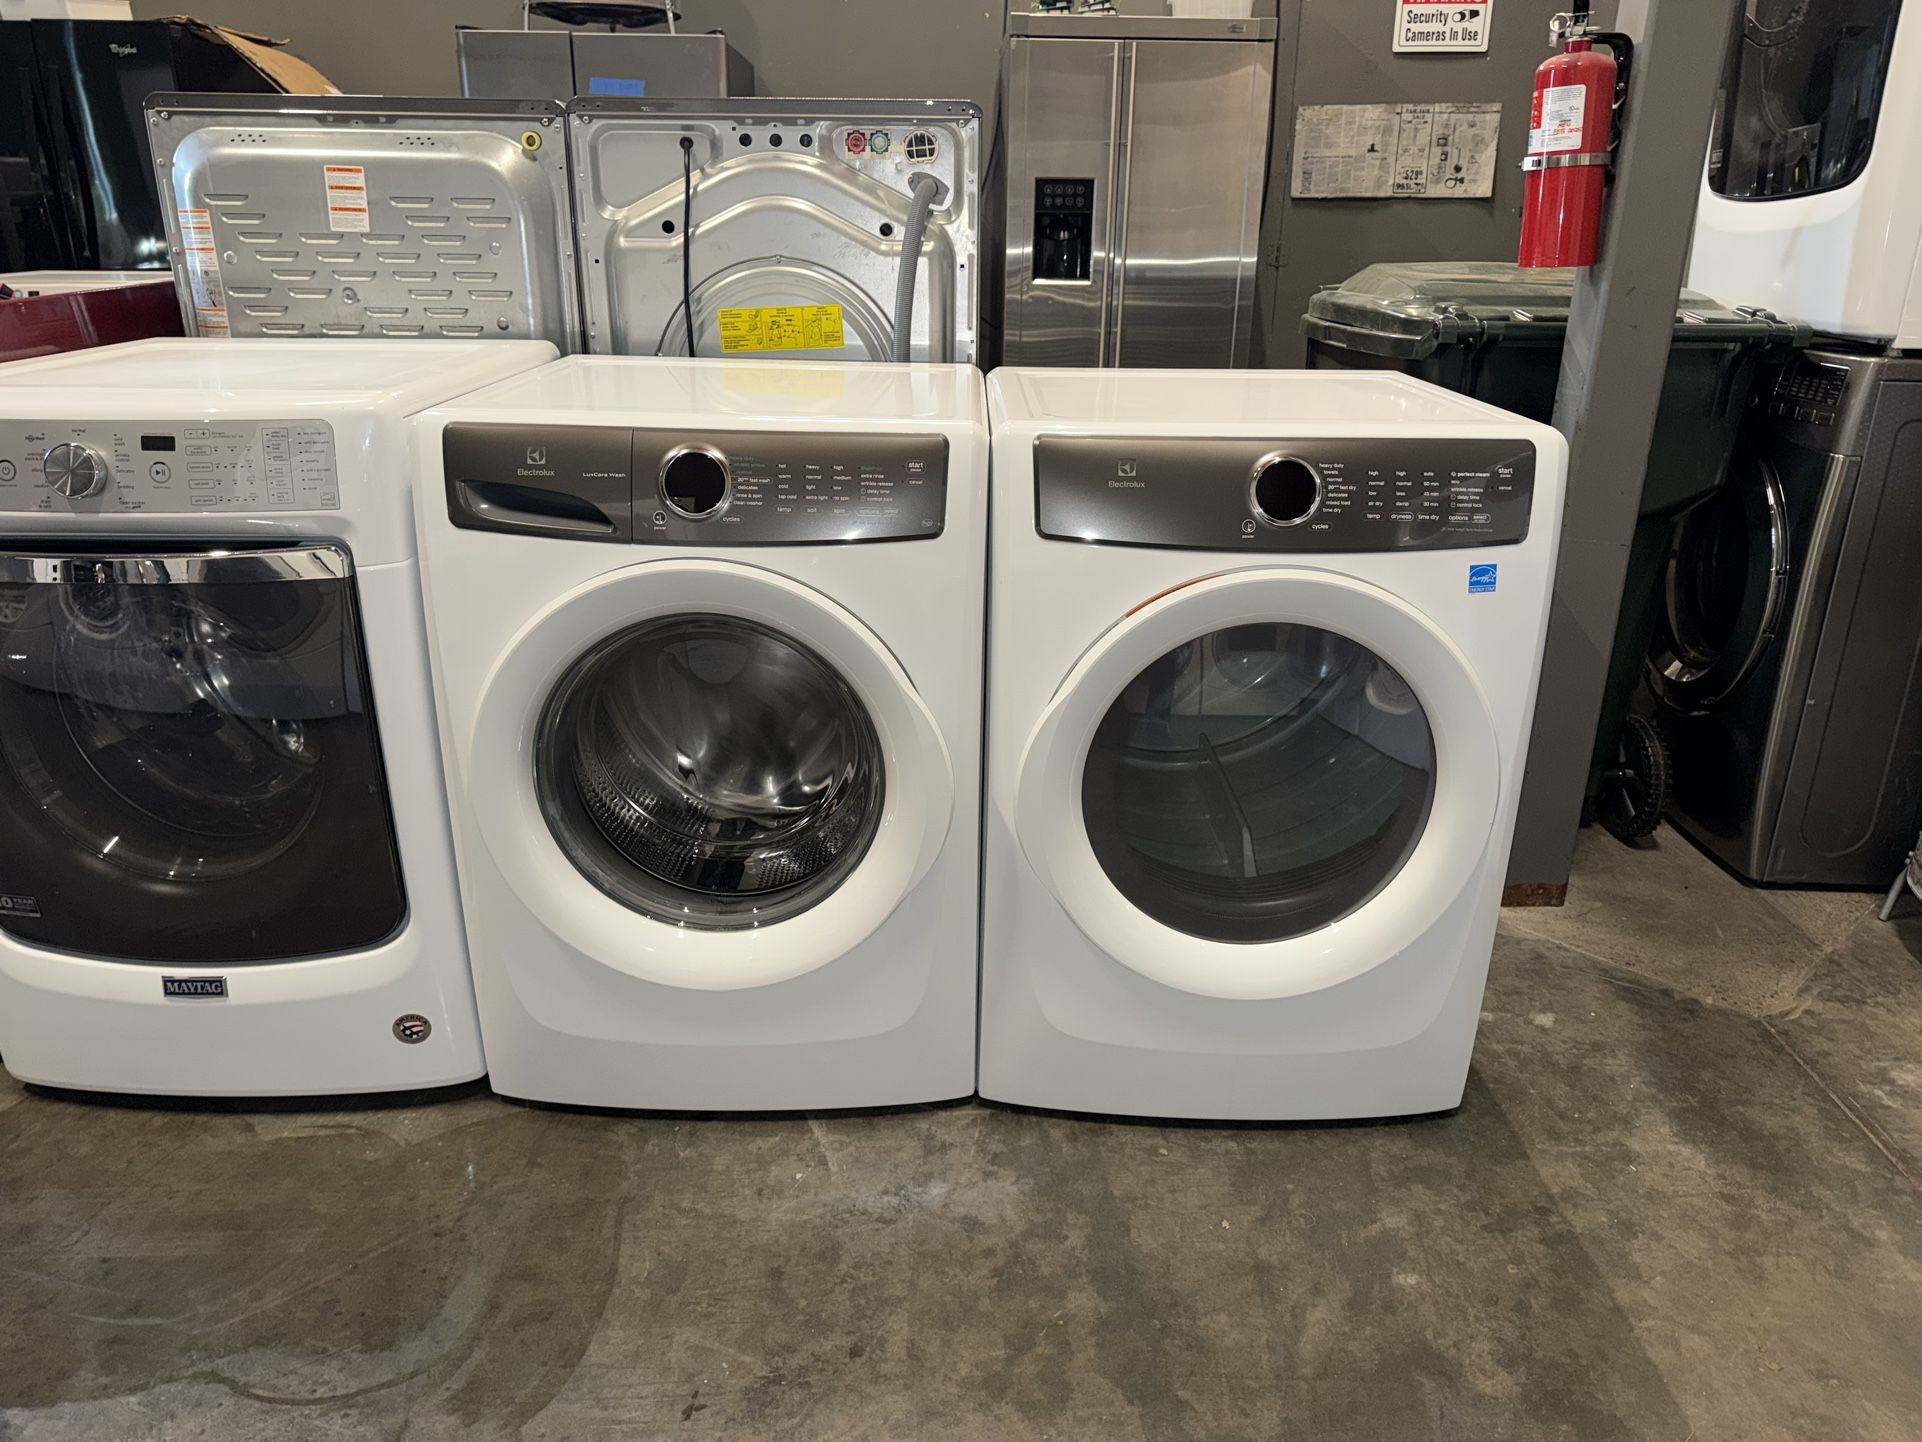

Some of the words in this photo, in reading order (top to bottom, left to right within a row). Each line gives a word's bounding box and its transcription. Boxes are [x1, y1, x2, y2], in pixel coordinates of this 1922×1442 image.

[1406, 10, 1449, 26] Security
[1405, 28, 1446, 42] Cameras
[1449, 27, 1458, 41] In
[1461, 27, 1478, 41] Use
[517, 468, 555, 476] Electrolux
[166, 982, 222, 993] MAYTAG
